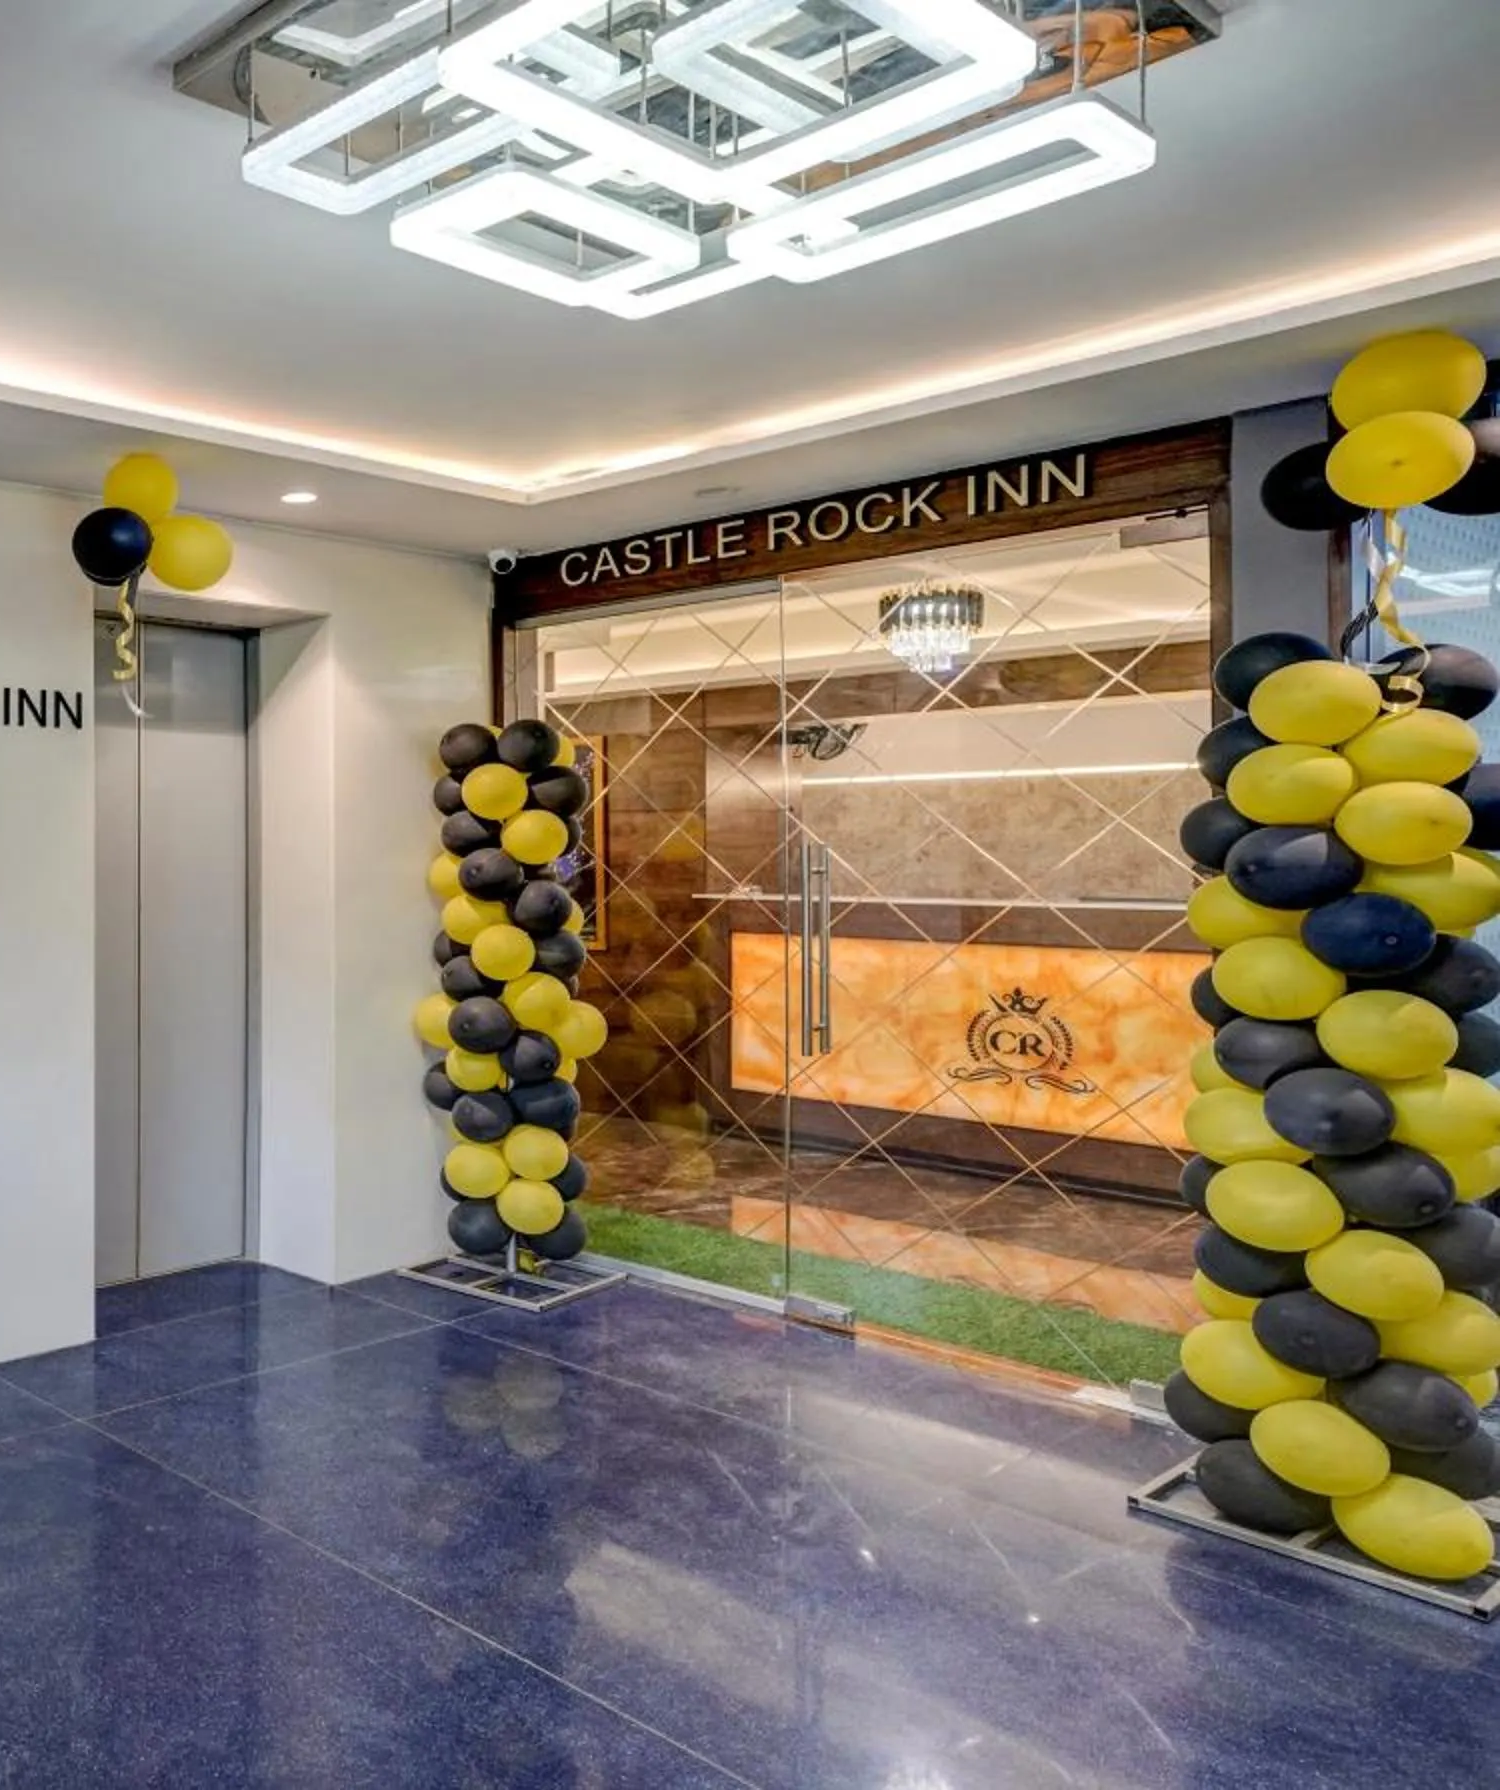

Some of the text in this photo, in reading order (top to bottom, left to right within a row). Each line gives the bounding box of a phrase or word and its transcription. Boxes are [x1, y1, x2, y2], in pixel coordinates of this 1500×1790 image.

[560, 454, 1088, 588] CASTLE ROCK INN
[2, 687, 83, 729] INN
[990, 1029, 1045, 1057] CR
